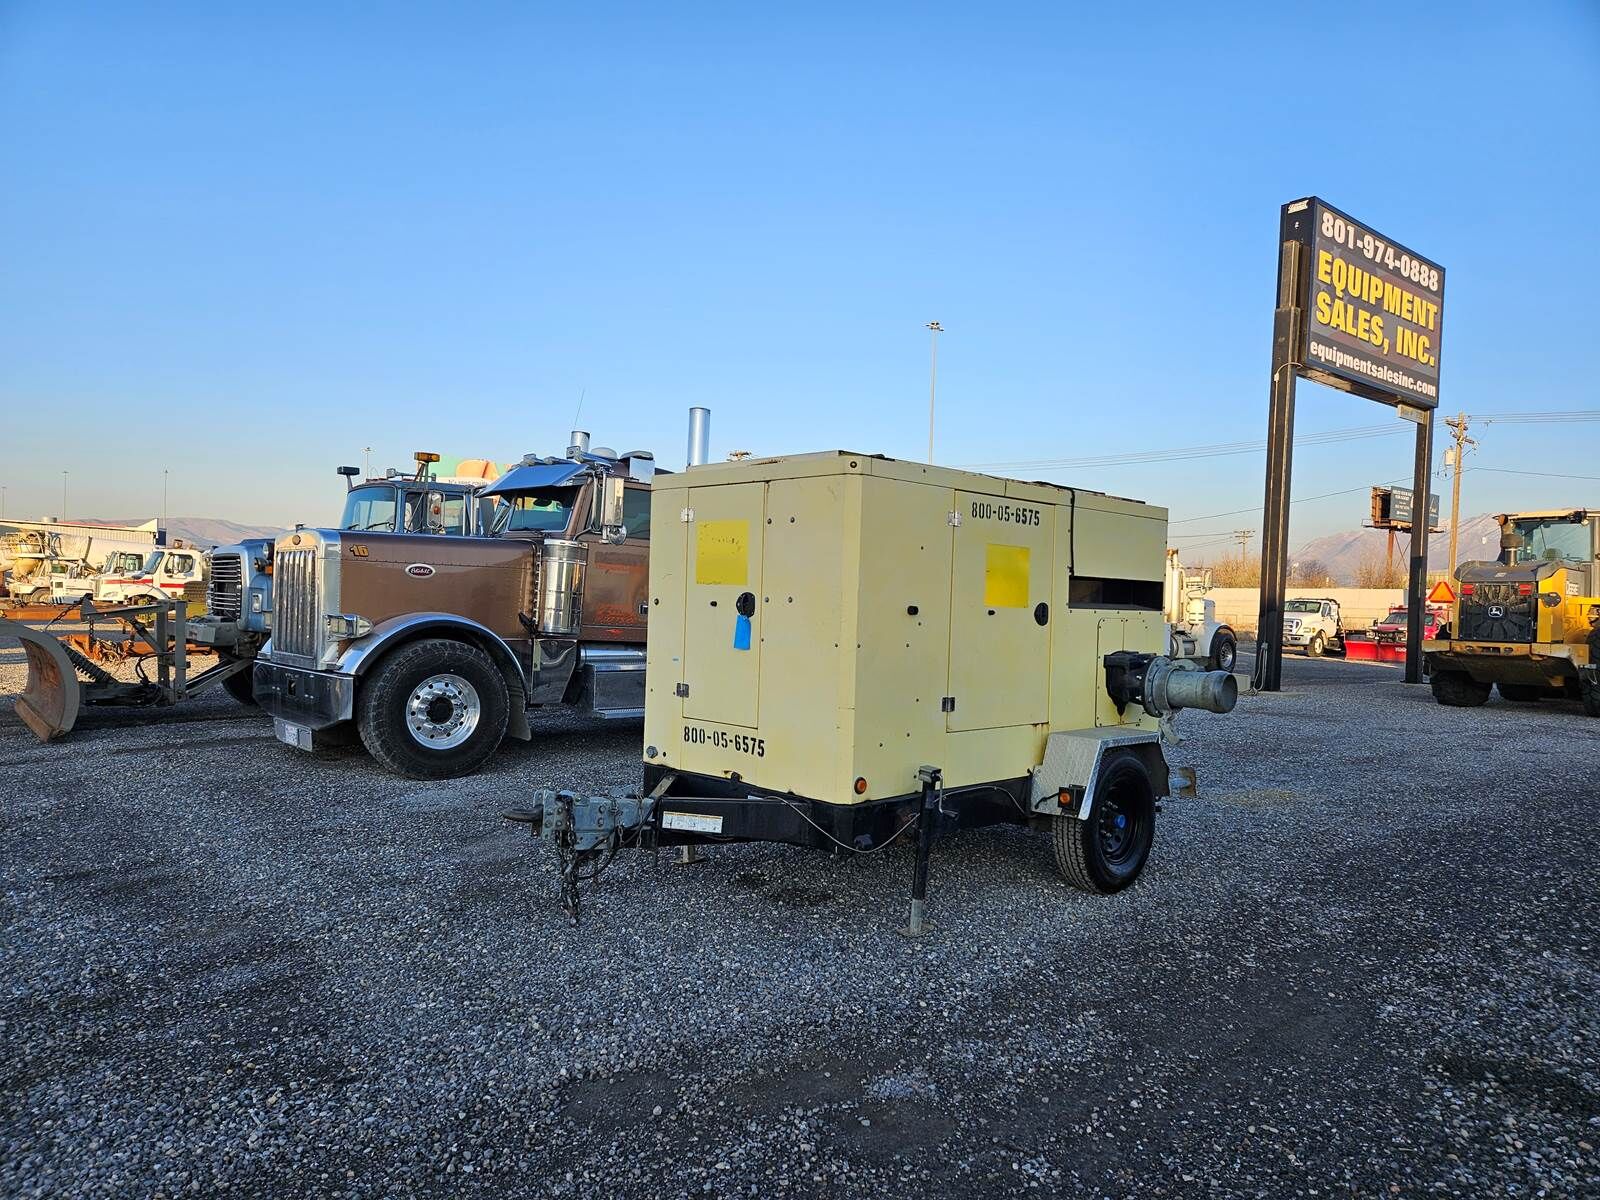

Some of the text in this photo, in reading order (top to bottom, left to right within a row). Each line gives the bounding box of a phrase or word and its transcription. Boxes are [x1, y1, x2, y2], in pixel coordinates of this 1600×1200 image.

[1321, 212, 1438, 292] 801-974-0888
[1317, 250, 1438, 331] EQUIPMENT
[1316, 291, 1435, 367] SALES, INC.
[1310, 341, 1436, 397] equipmentsalesinc.com
[970, 501, 1041, 526] 800-05-6575
[683, 725, 766, 758] 800-05-6575
